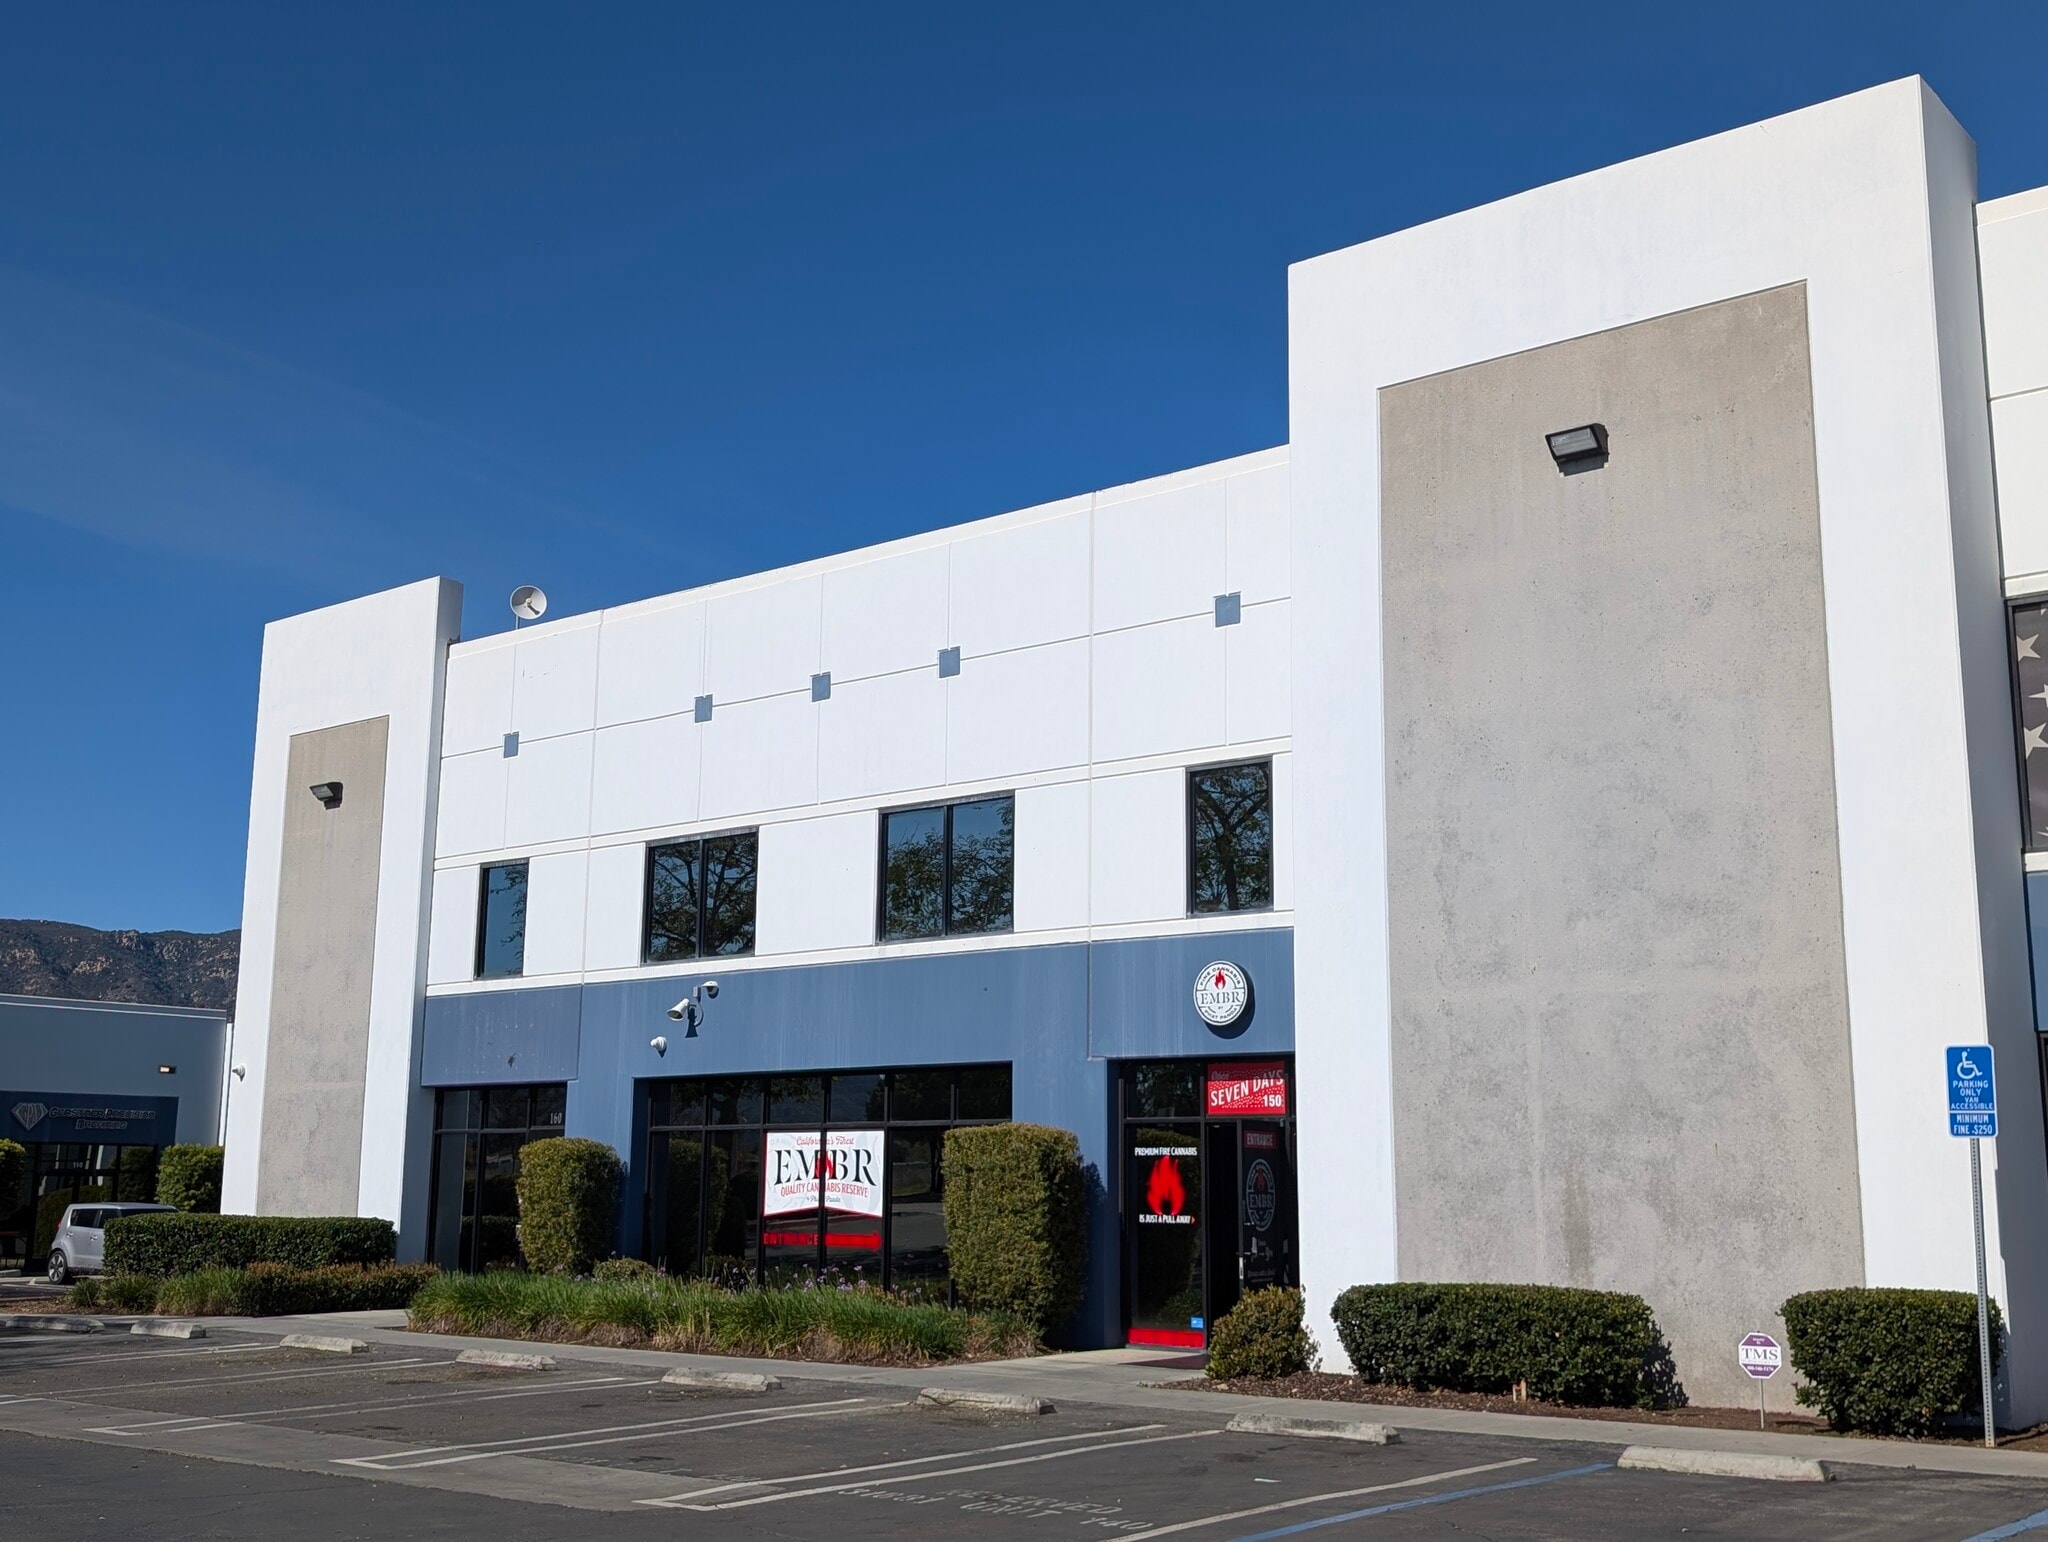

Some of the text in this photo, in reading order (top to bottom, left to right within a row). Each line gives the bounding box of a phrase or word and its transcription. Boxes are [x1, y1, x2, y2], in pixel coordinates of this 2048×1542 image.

[1200, 991, 1241, 1005] EMBR
[1211, 1069, 1284, 1107] SEVEN DAYS
[1952, 1080, 1989, 1088] PARKING
[1960, 1088, 1982, 1096] ONLY
[1263, 1094, 1282, 1107] 150
[1950, 1102, 1993, 1110] ACCESSIBLE
[550, 1112, 563, 1124] 160
[1956, 1114, 1989, 1124] MINIMUM
[1953, 1124, 1993, 1135] FINE $250
[774, 1149, 878, 1186] EMBR
[780, 1181, 869, 1198] QUALITY CANABIS RESERVE
[1250, 1194, 1273, 1208] EMBR
[1741, 1347, 1778, 1360] TMS
[960, 1501, 1062, 1518] UNIT
